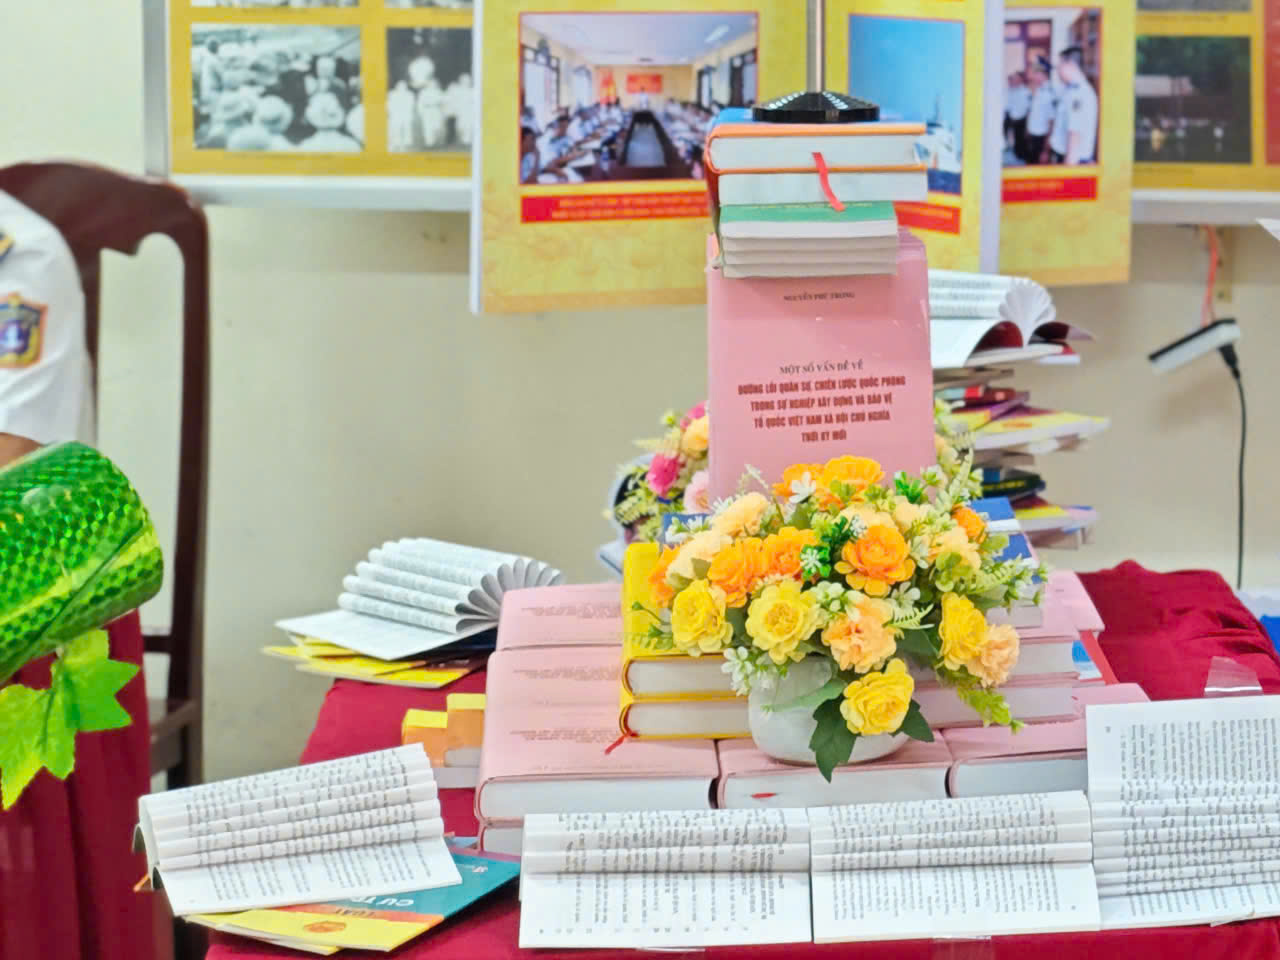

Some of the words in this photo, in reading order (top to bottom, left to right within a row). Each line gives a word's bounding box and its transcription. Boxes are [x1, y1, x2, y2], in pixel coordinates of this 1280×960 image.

[751, 400, 775, 411] TRONG
[788, 415, 803, 427] VIỆT
[806, 414, 822, 425] NAM
